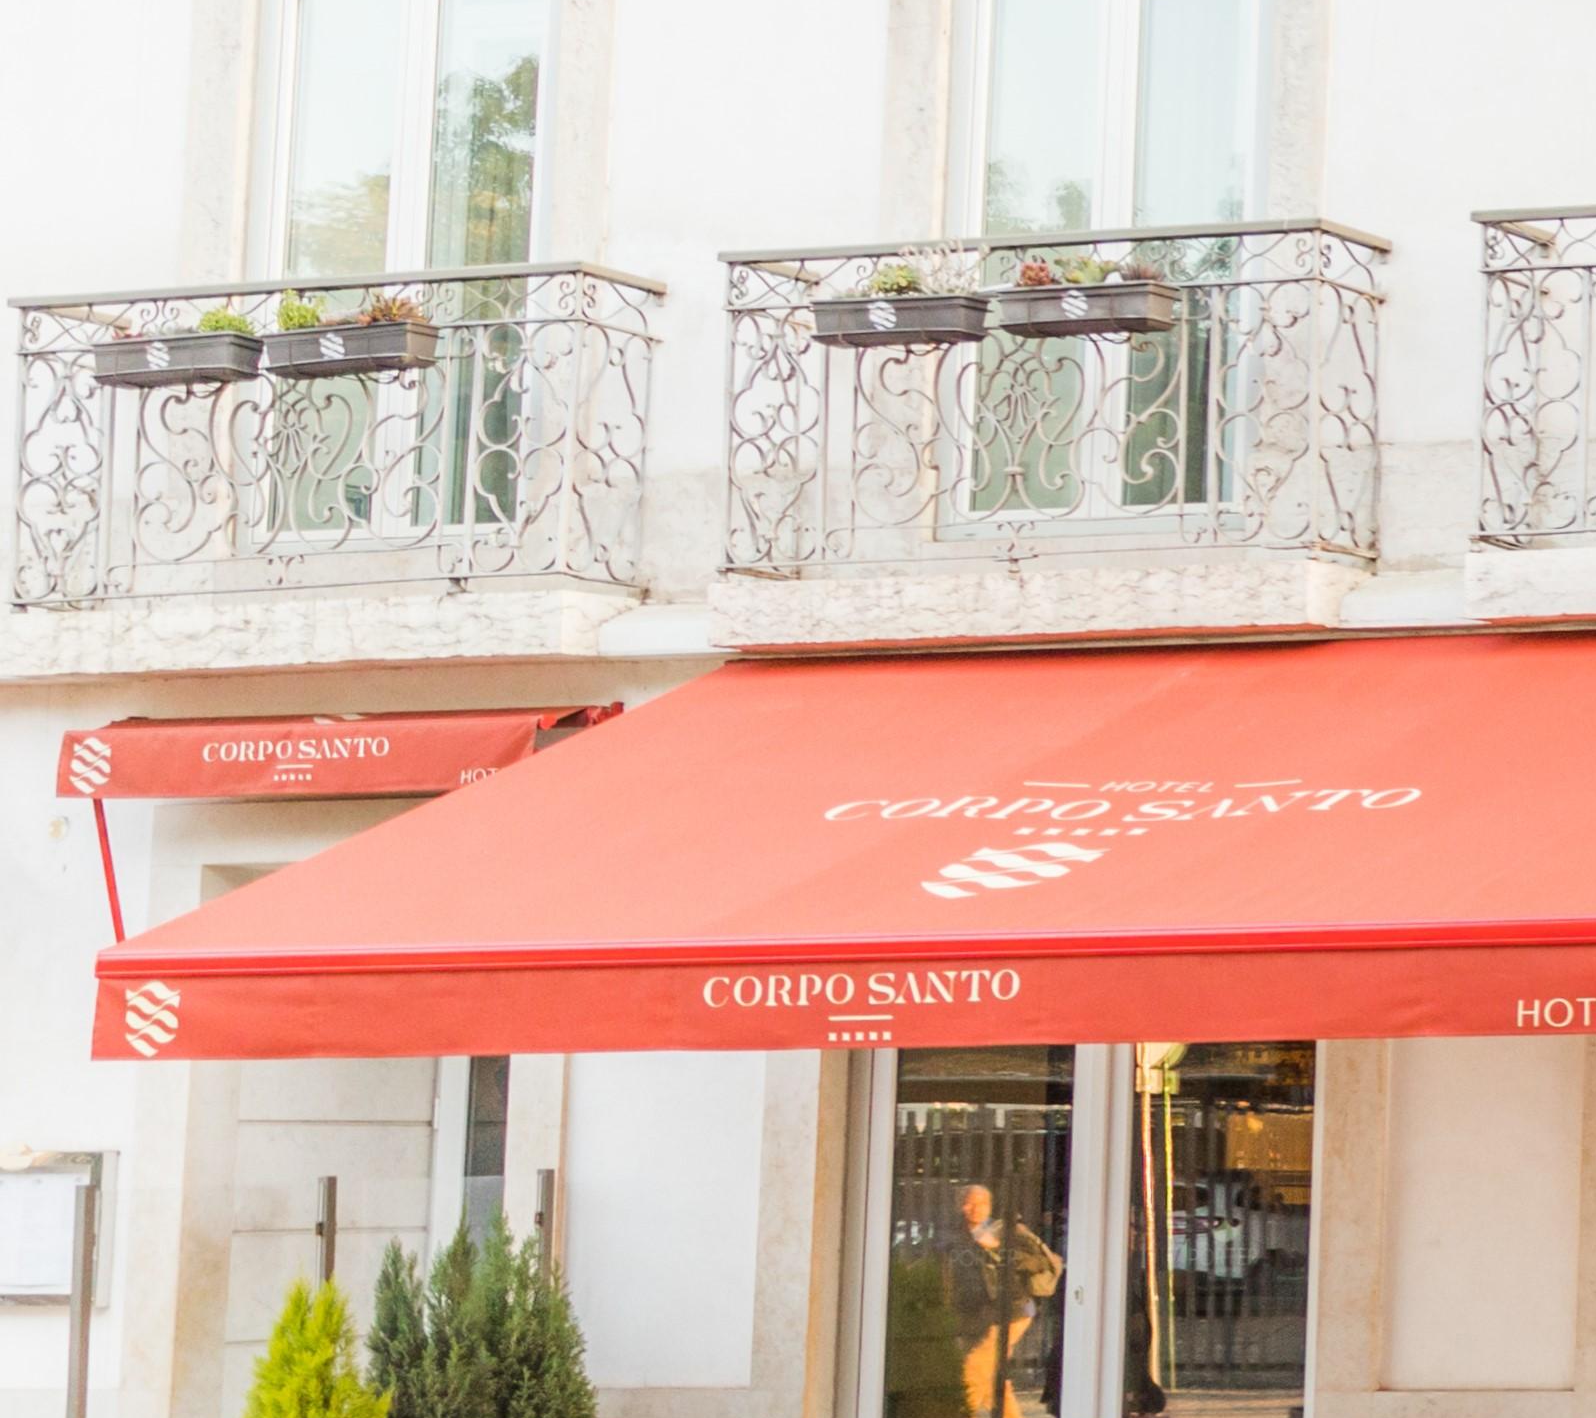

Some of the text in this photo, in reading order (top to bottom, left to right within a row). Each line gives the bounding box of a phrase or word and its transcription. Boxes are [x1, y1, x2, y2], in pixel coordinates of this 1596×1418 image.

[201, 735, 390, 763] CORPO SANTO
[1098, 779, 1217, 794] HOTEL
[824, 786, 1422, 823] CORPO SANTO
[703, 967, 1022, 1009] CORPO SANTO
